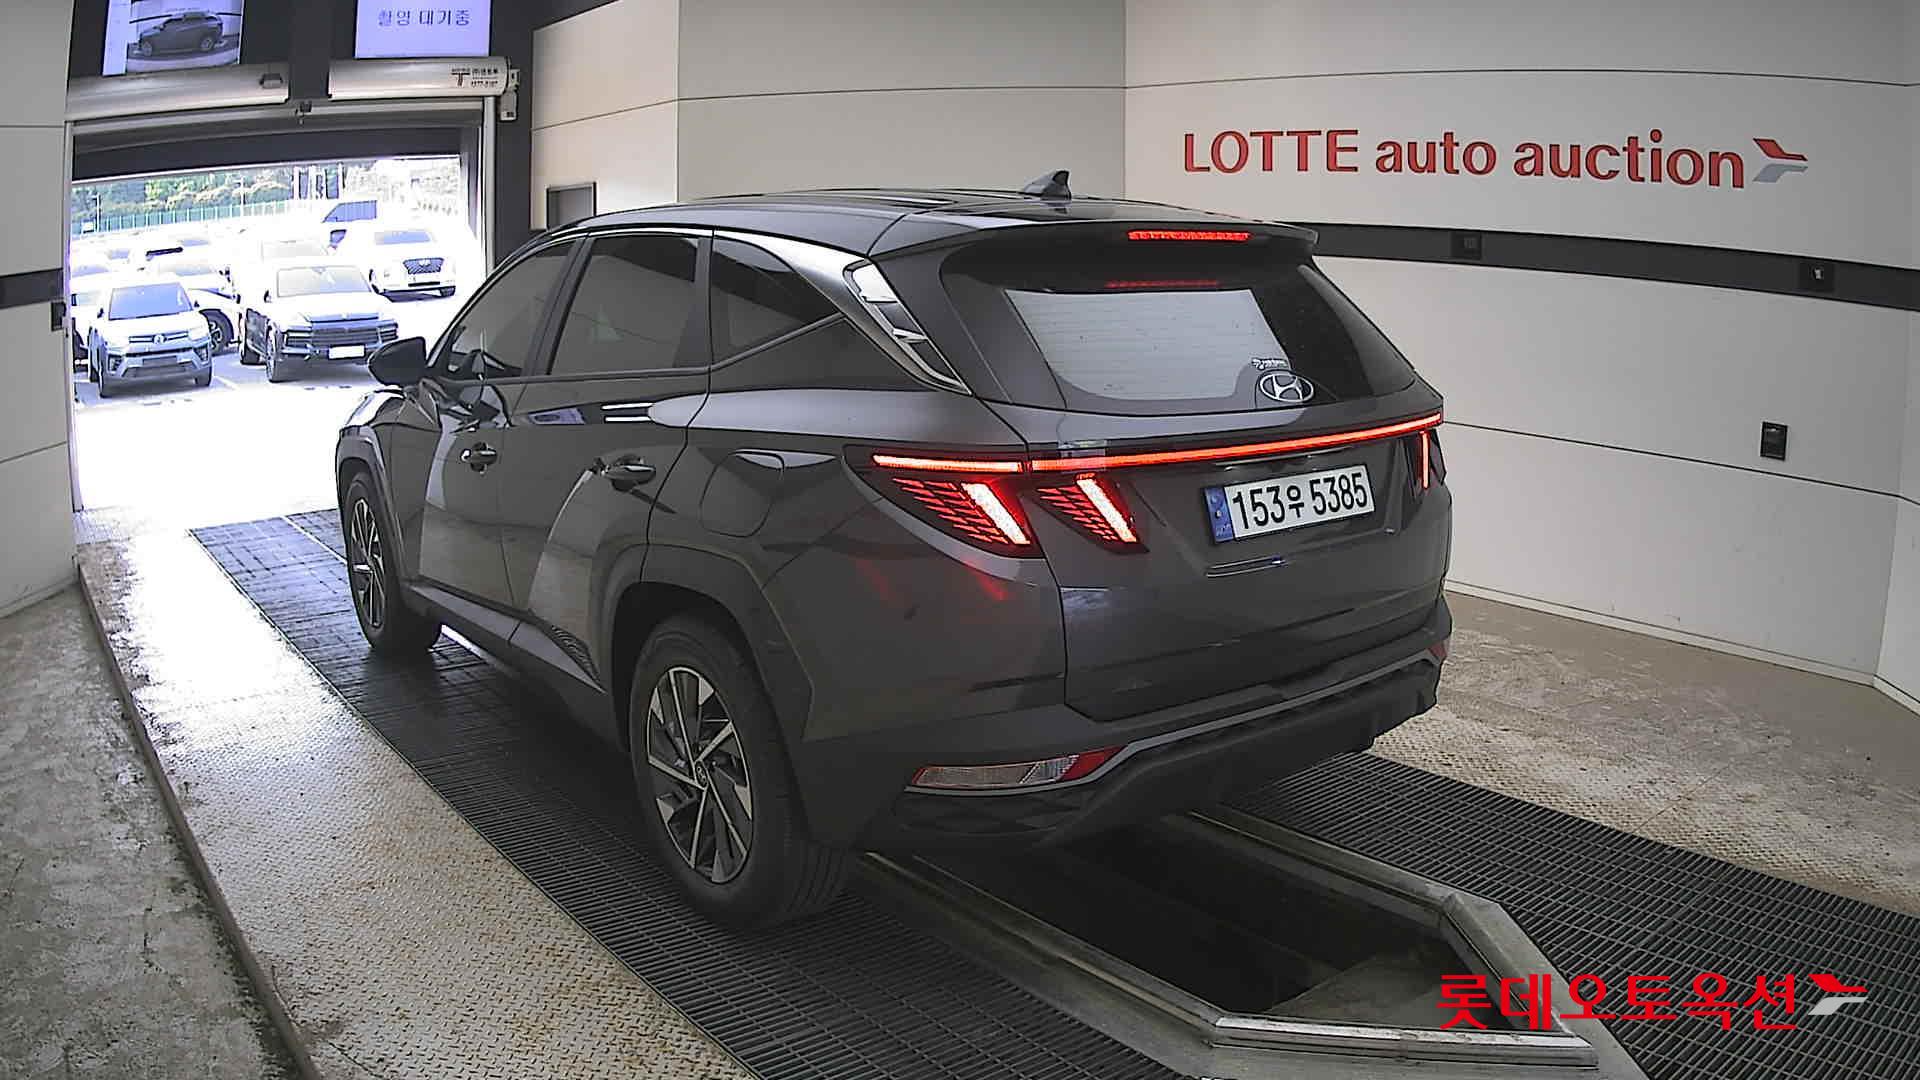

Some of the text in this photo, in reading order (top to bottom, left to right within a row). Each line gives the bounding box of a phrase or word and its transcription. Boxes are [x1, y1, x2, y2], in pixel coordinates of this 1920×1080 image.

[419, 10, 470, 26] 대기중
[1184, 128, 1745, 189] LOTTE auto auction
[1232, 472, 1368, 530] 153우 5385
